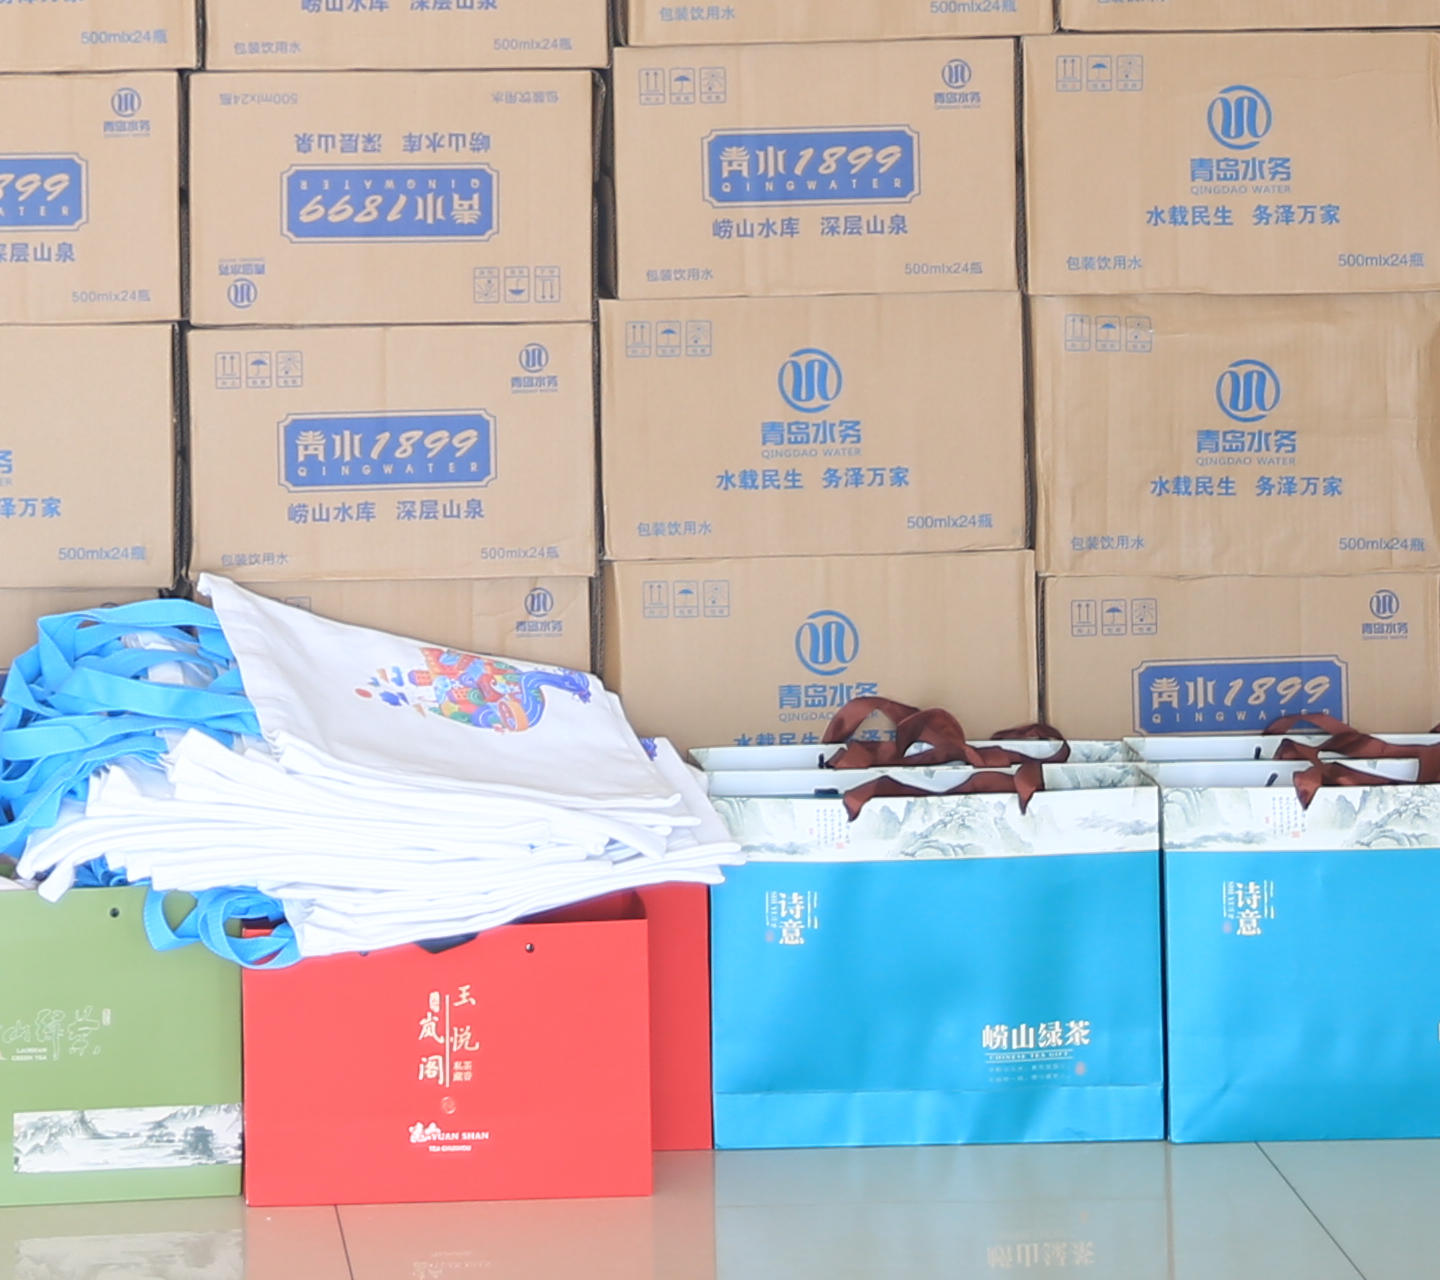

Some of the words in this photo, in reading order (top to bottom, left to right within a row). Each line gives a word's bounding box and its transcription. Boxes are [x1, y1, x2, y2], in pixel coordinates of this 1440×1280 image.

[1190, 157, 1292, 182] 青岛水务
[1190, 185, 1247, 197] QINGDAO
[1251, 184, 1292, 194] WATER
[712, 217, 799, 239] 崂山水库
[822, 214, 909, 236] 深层山泉
[1146, 205, 1235, 227] 水载民生
[1252, 204, 1341, 226] 务泽万家
[761, 420, 863, 446] 青岛水务
[1197, 429, 1297, 453] 青岛水务
[716, 468, 804, 491] 水载民生
[822, 466, 911, 489] 务泽万家
[1150, 475, 1237, 497] 水载民生
[1256, 475, 1344, 497] 务泽万家
[288, 502, 375, 523] 崂山水库
[398, 498, 484, 520] 深层山泉
[778, 892, 805, 944] 诗意
[1236, 881, 1262, 936] 诗意
[982, 1020, 1090, 1050] 崂山绿茶
[462, 1132, 489, 1140] SHAN
